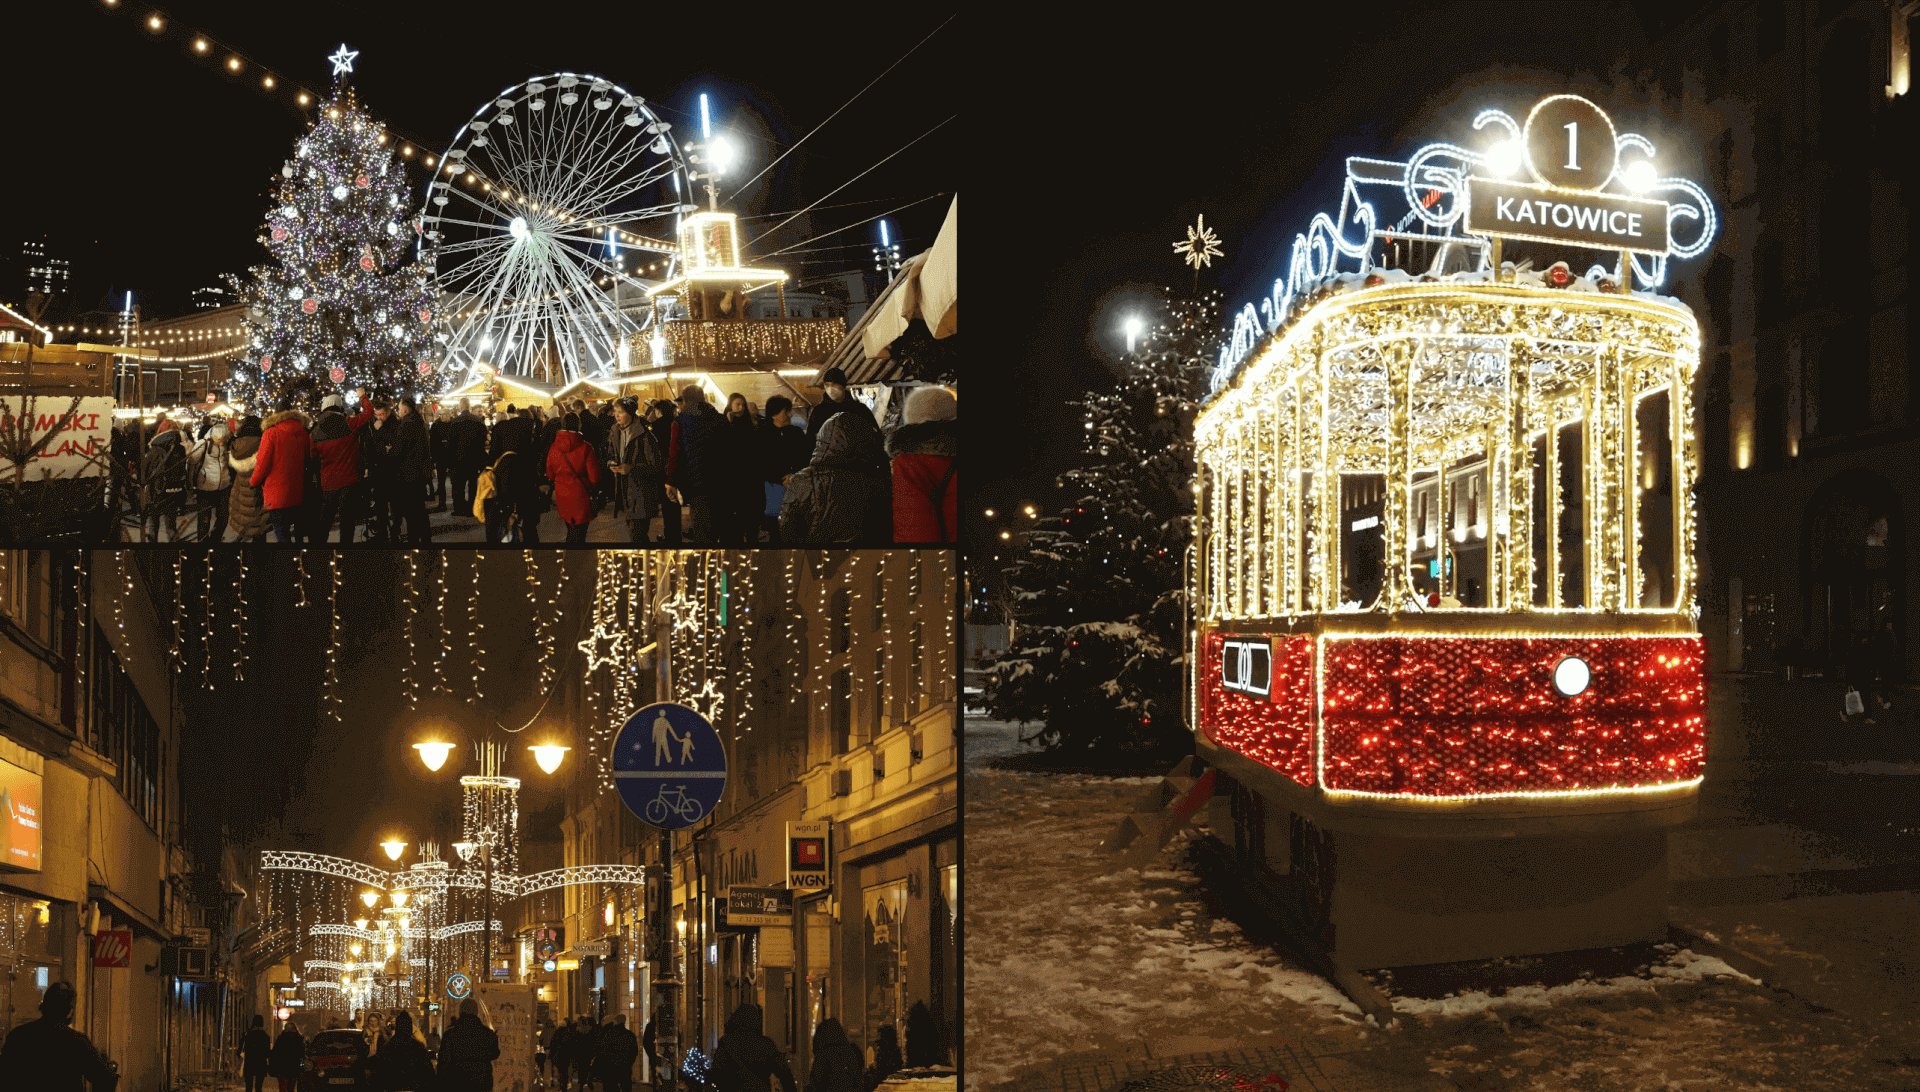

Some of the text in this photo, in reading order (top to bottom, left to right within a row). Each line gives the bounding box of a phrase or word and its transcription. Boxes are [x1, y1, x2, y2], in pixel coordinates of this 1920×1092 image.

[1563, 121, 1581, 170] 1
[1496, 195, 1642, 237] KATOWICE
[795, 824, 821, 833] wgn.pl
[790, 874, 826, 887] WGN
[730, 890, 765, 899] Agencja
[730, 900, 753, 908] Lokal
[95, 936, 129, 964] illy
